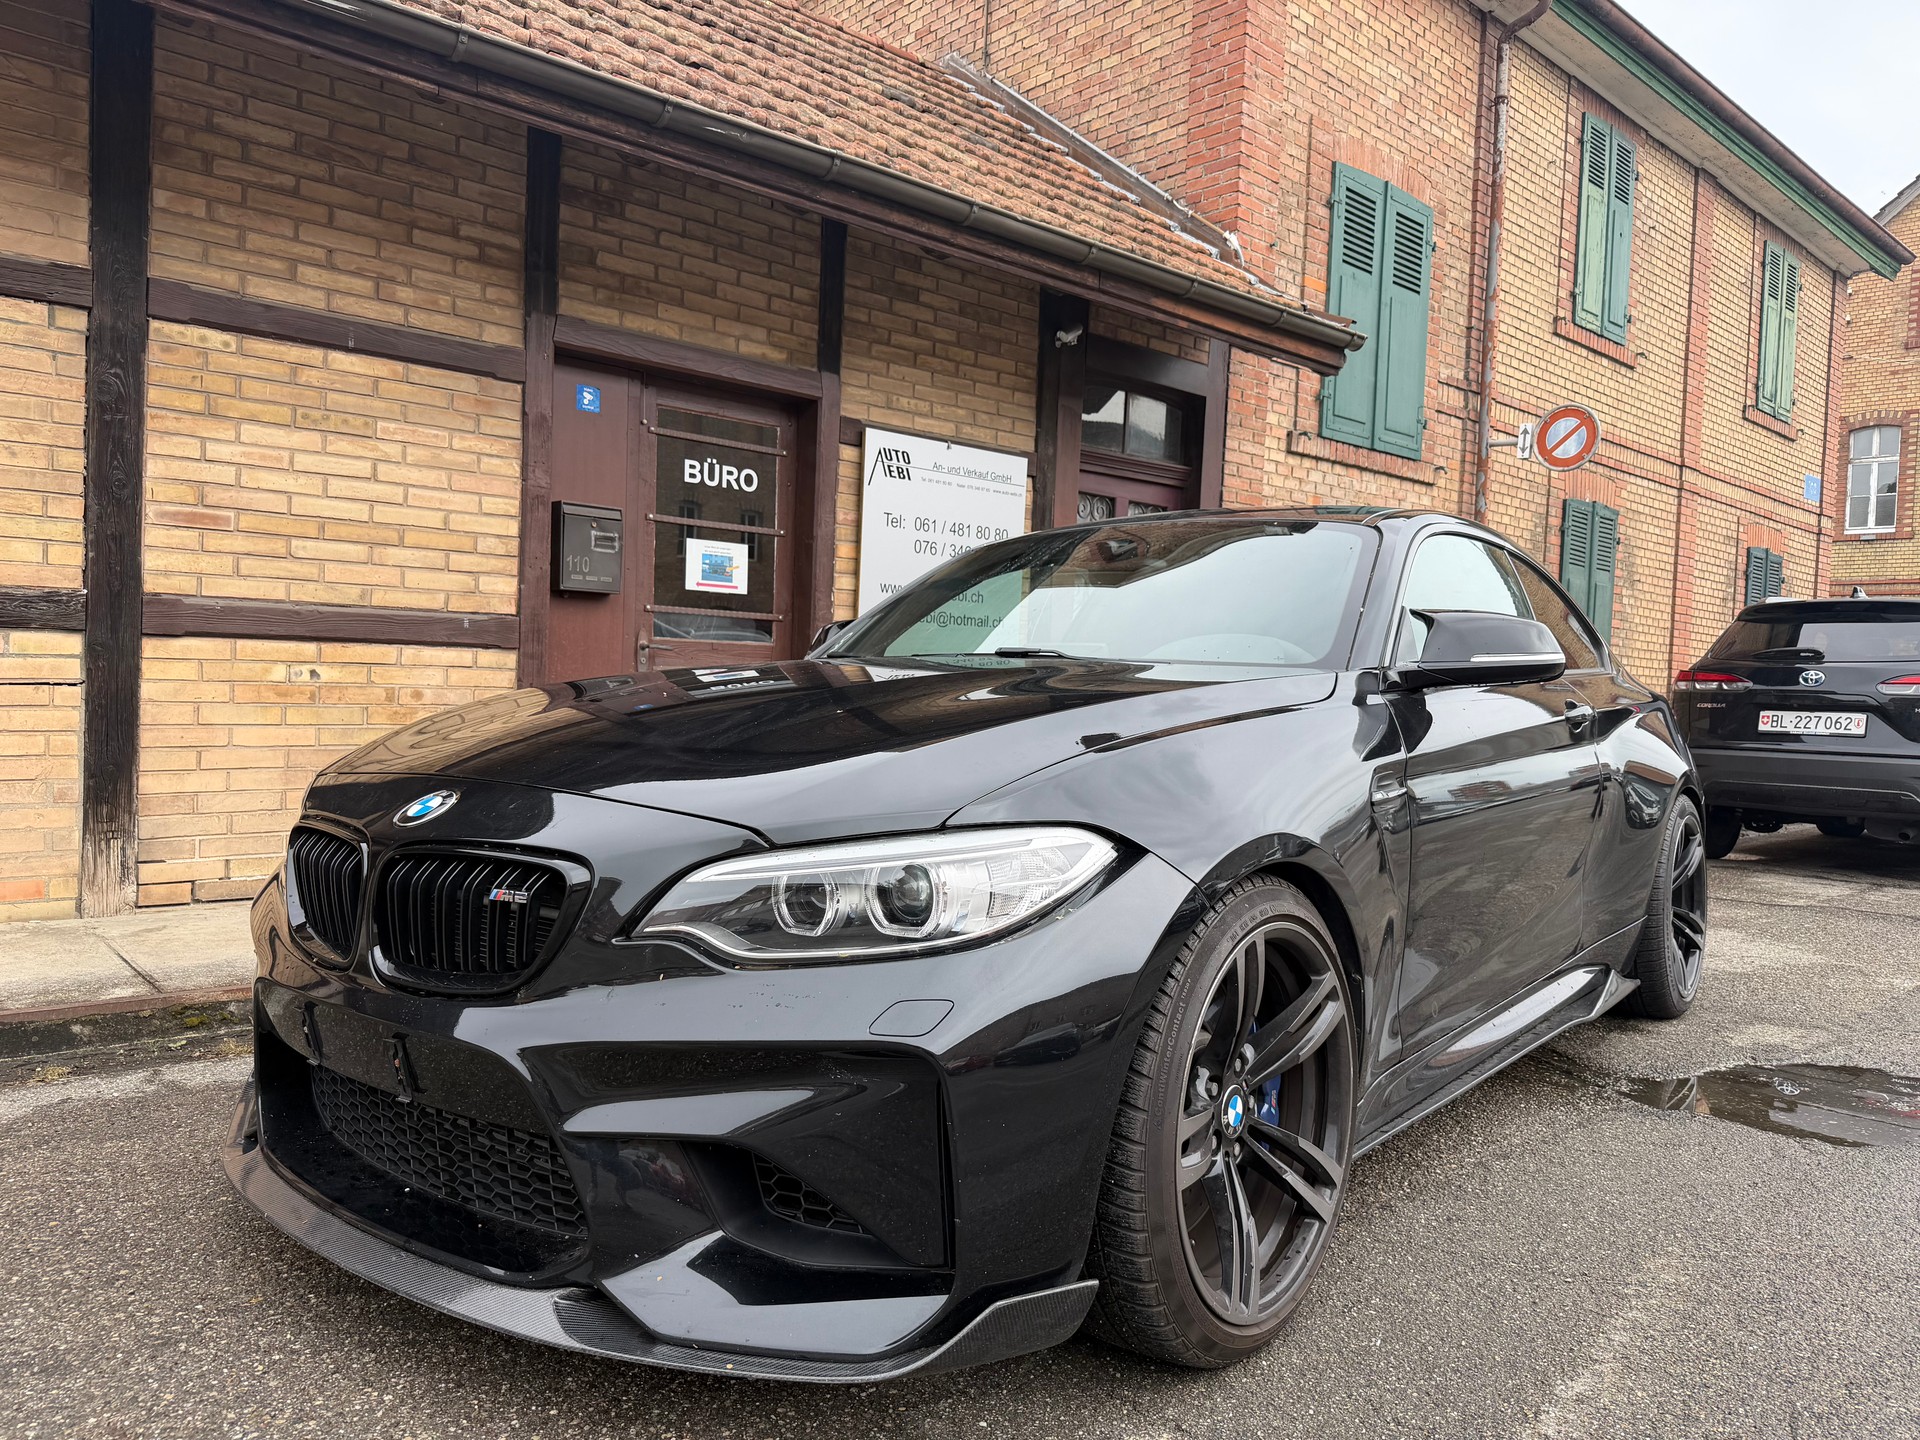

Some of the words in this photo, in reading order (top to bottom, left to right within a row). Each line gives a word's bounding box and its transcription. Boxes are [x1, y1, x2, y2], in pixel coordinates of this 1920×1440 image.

[683, 457, 759, 493] BÜRO
[932, 461, 946, 471] An-
[947, 466, 961, 475] und
[962, 466, 989, 479] Verkauf
[990, 471, 1012, 483] GmbH
[883, 512, 906, 530] Tel:
[914, 516, 937, 534] 061
[941, 520, 947, 535] /
[949, 522, 971, 538] 481
[975, 525, 991, 541] 80
[994, 527, 1009, 541] 80
[914, 539, 938, 556] 076
[940, 542, 947, 557] /
[566, 554, 590, 573] 110
[489, 888, 528, 904] M2
